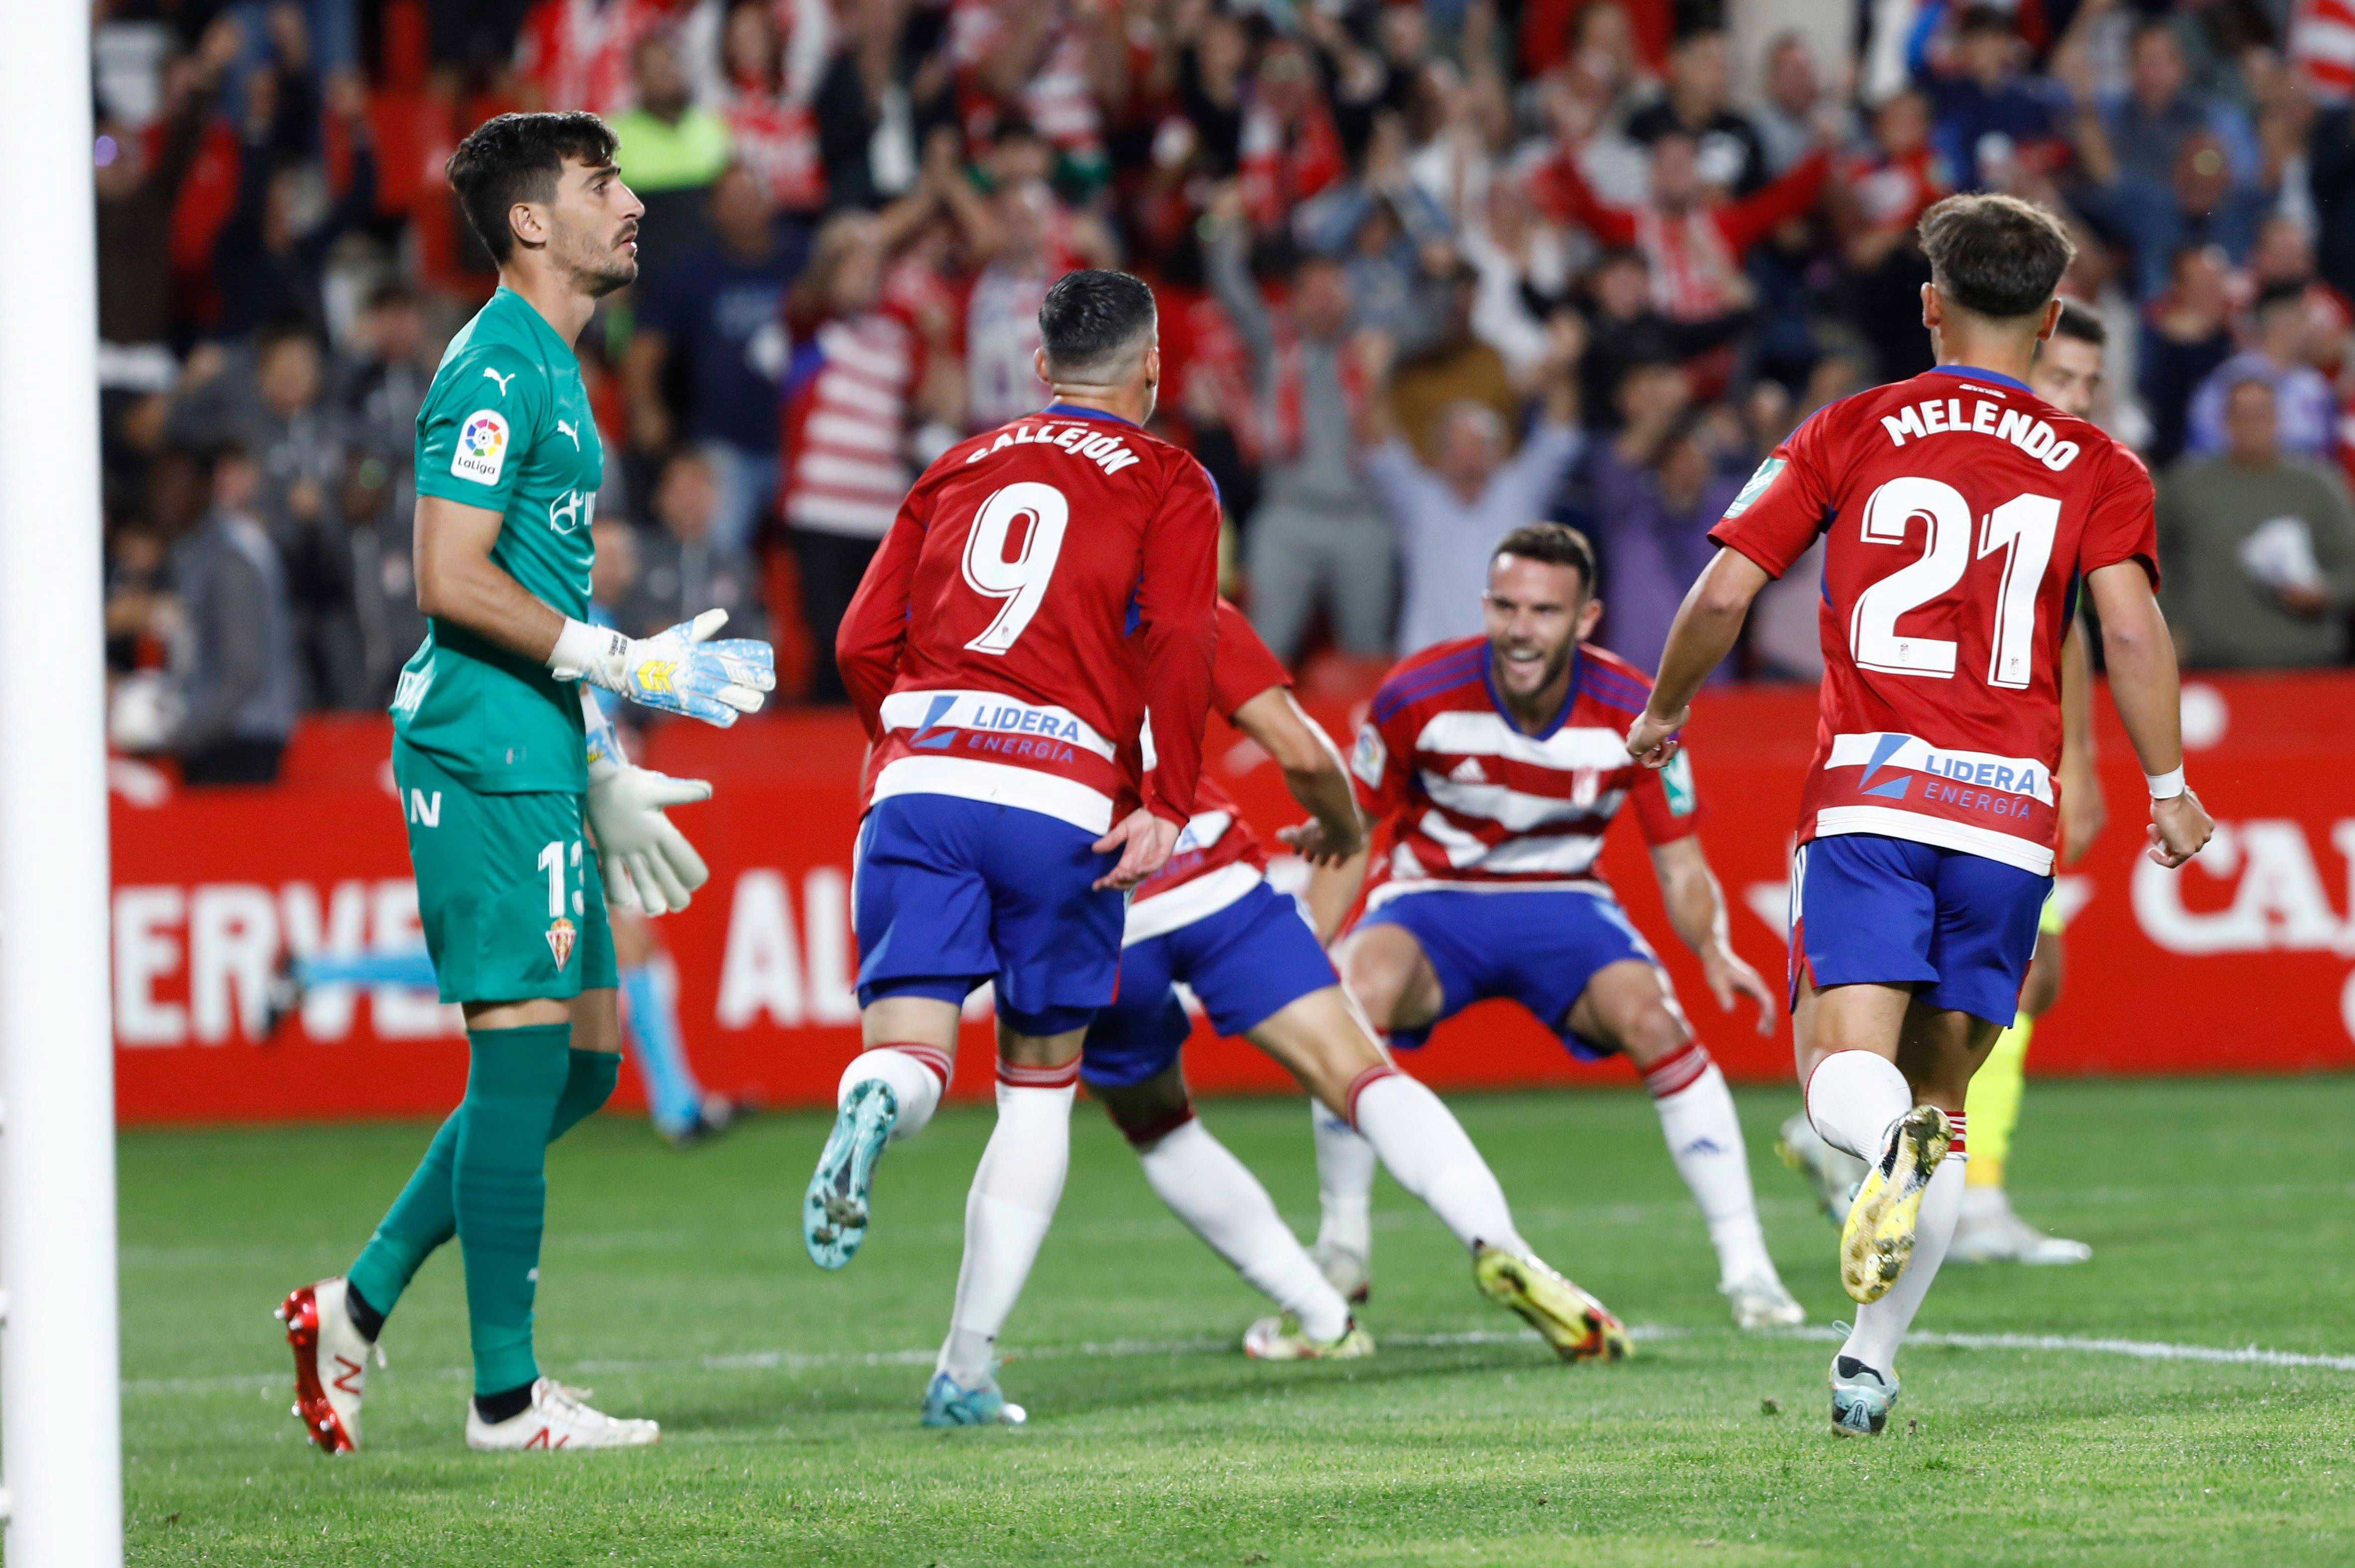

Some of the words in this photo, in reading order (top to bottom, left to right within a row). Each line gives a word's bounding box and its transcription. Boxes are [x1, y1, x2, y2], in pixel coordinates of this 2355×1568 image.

[965, 425, 1140, 475] CALLEJÓN
[1880, 398, 2080, 472] MELENDO
[458, 457, 496, 474] LaLiga
[961, 481, 1070, 655] 9
[1849, 476, 2062, 690] 21
[972, 705, 1079, 742] LIDERA
[967, 734, 1074, 764] ENERGÍA
[1925, 754, 2034, 795] LIDERA
[1924, 781, 2030, 821] ENERGÍA
[2129, 817, 2355, 958] CA
